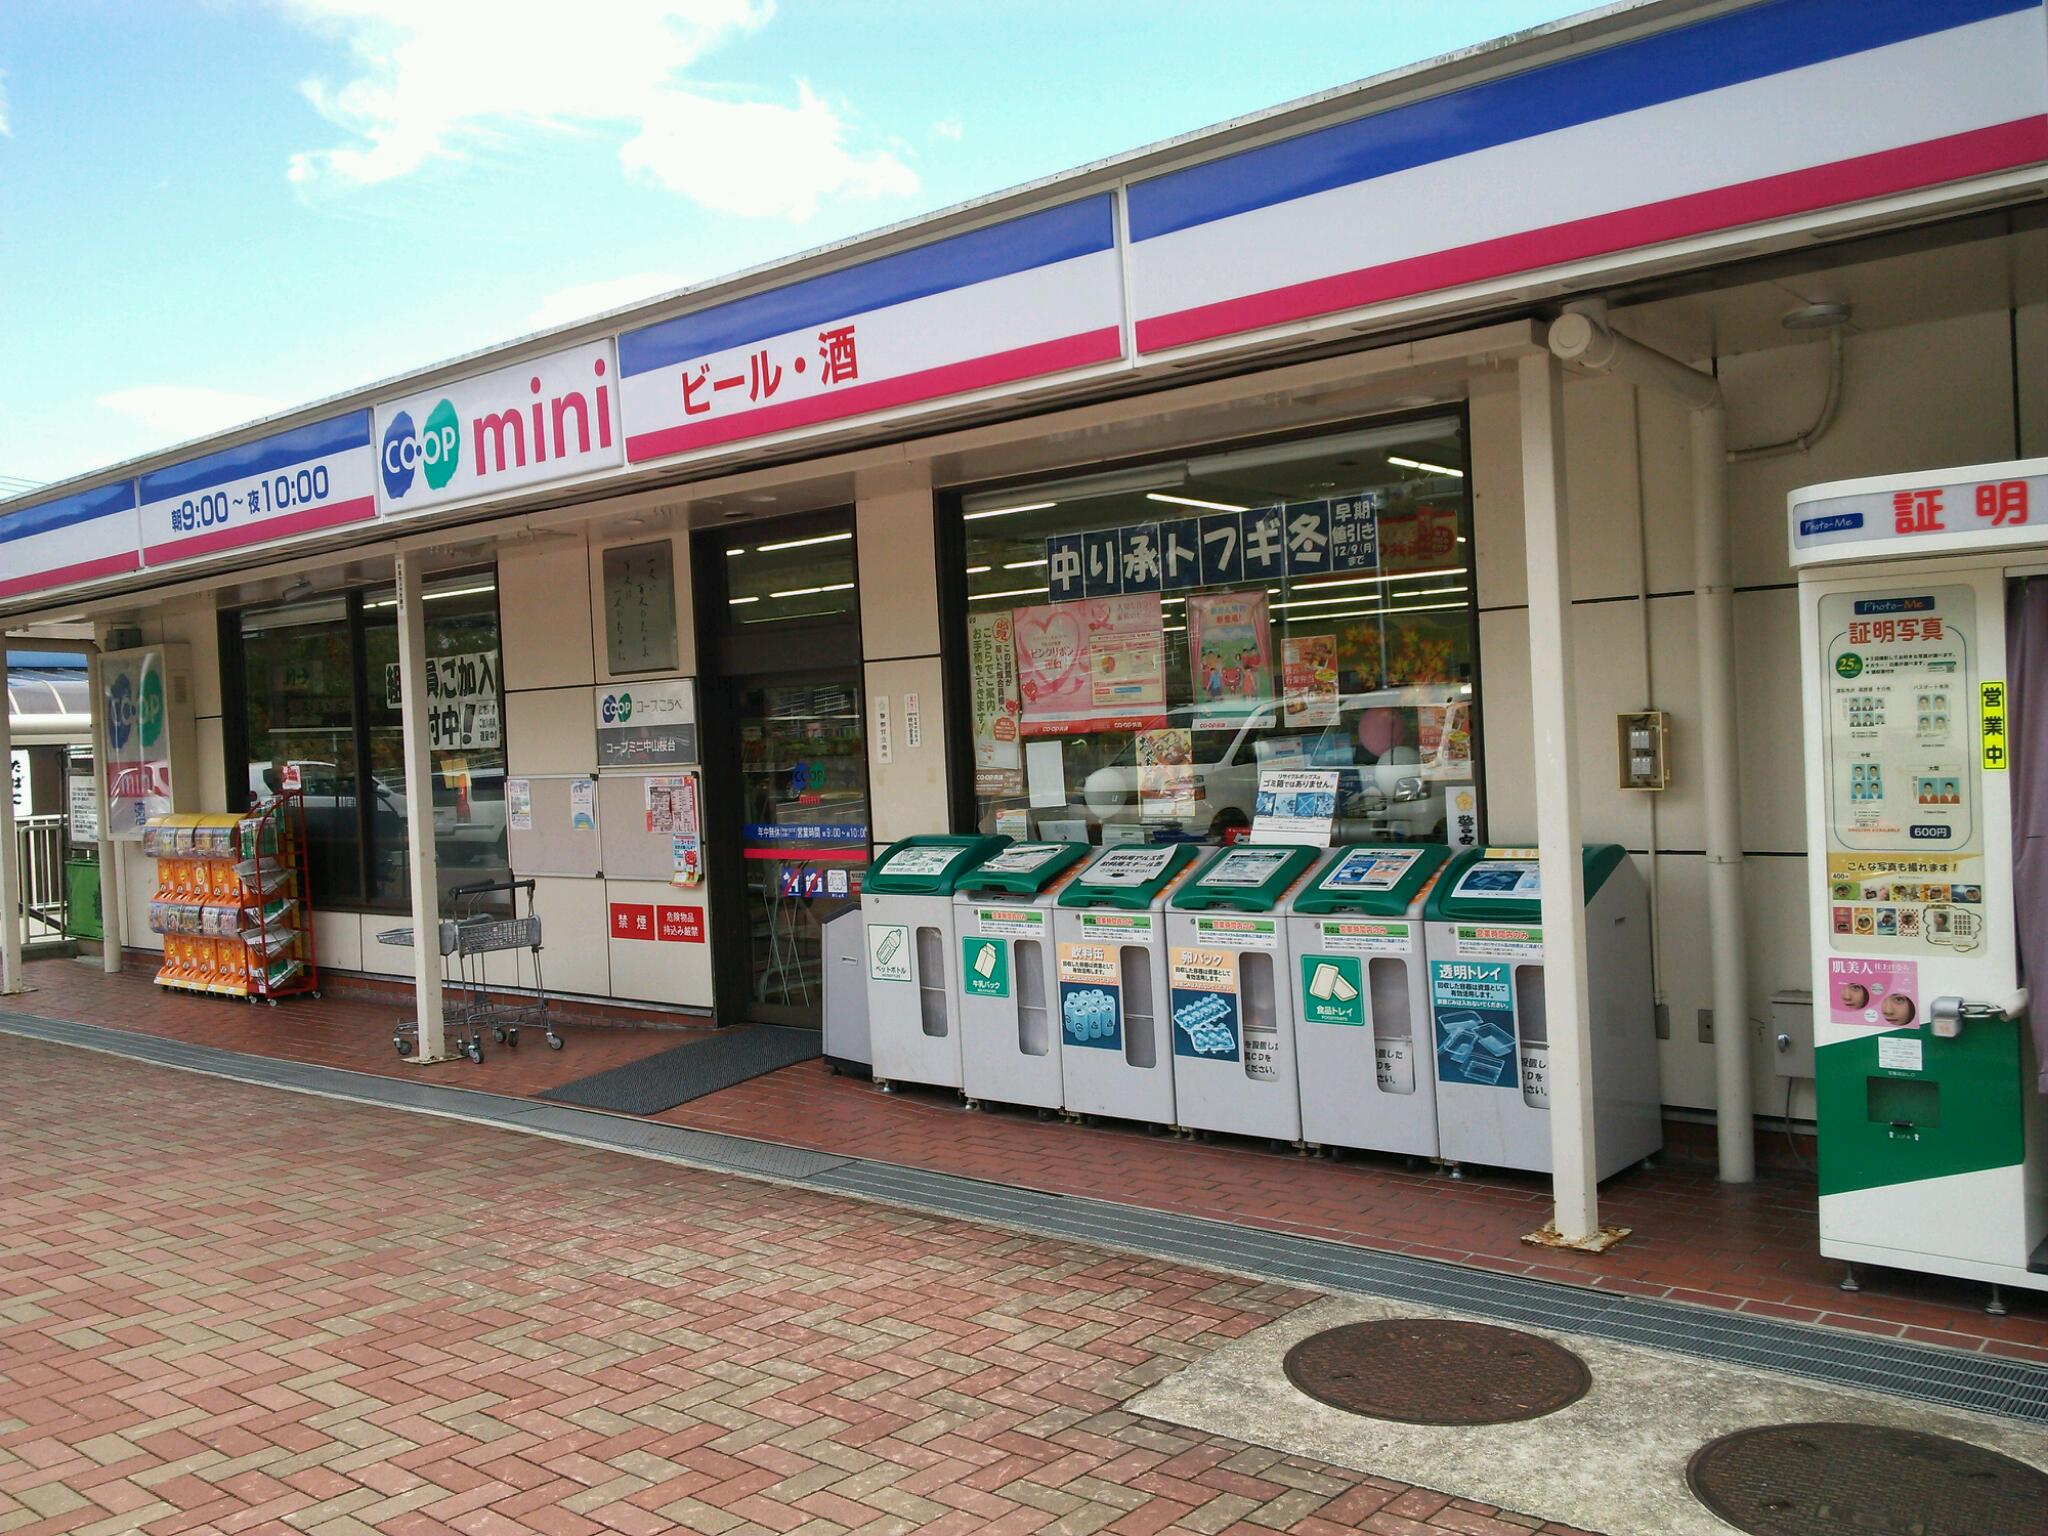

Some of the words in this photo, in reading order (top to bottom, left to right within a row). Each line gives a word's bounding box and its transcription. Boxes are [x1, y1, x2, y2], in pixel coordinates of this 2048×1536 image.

[682, 325, 858, 416] ビール・酒
[473, 358, 612, 476] mini
[1336, 500, 1371, 522] 早期
[1804, 518, 1853, 532] Photo-Me
[1332, 523, 1375, 544] 値引き
[1348, 555, 1365, 566] まで
[1864, 600, 1924, 612] Photo-Me
[1849, 617, 1944, 645] 証明写真
[386, 653, 495, 704] 組員ご加入
[636, 698, 683, 713] コープこうべ
[1982, 685, 2006, 765] 営業中
[1914, 827, 1947, 837] 600円
[618, 913, 647, 930] 禁煙
[1072, 945, 1104, 961] 飲料缶
[1182, 951, 1224, 967] 卵パック
[875, 965, 907, 974] ペットボトル
[1439, 964, 1501, 981] 透明トレイ
[1832, 960, 1873, 975] 肌美人
[972, 980, 1000, 990] 牛乳パック
[1437, 982, 1506, 992] 回収した容器は資源として
[1316, 1005, 1353, 1016] 食品トレイ
[1375, 1048, 1403, 1059] 置した
[1523, 1085, 1548, 1096] さい。
